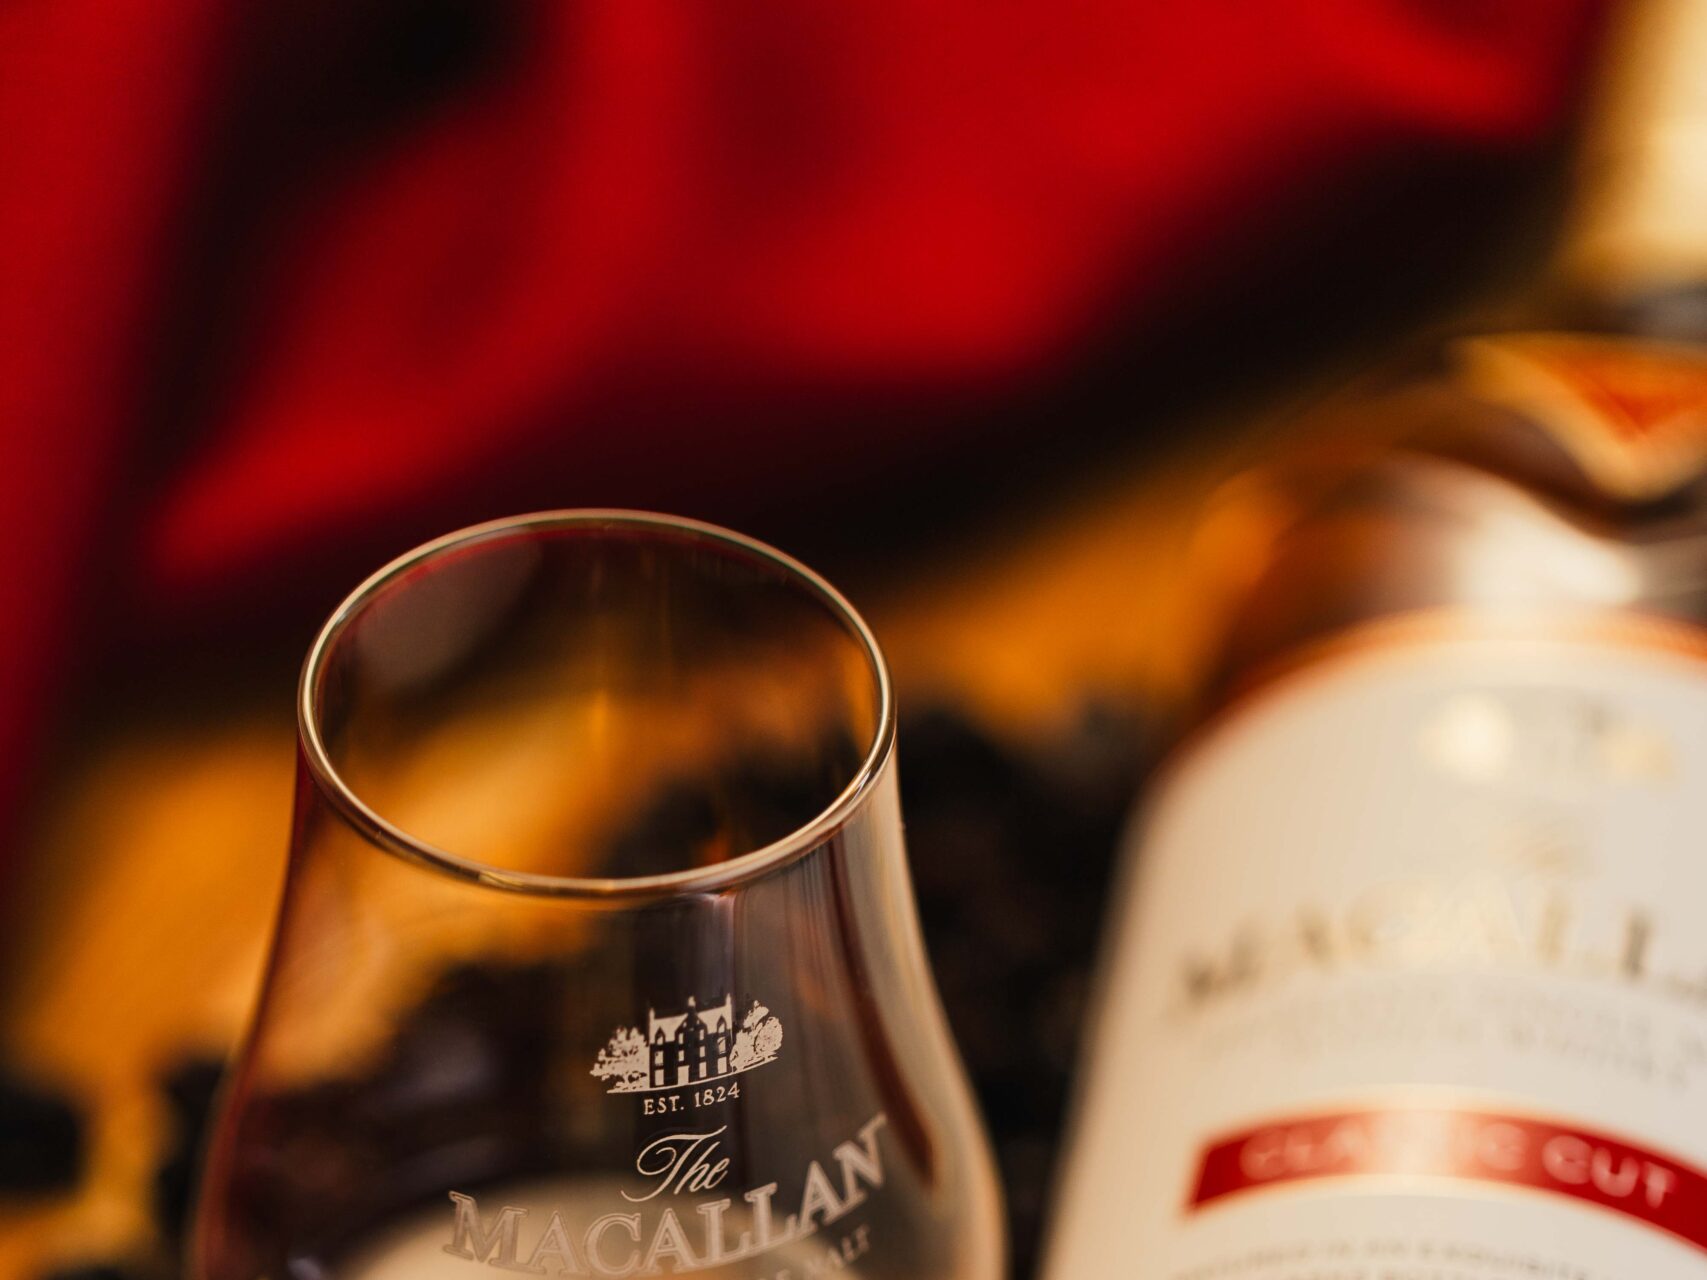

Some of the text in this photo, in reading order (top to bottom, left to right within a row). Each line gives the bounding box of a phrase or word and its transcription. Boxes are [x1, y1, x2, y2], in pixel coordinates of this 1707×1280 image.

[643, 1082, 741, 1115] EST. 1824
[442, 1112, 888, 1279] MACALLAN
[620, 1125, 731, 1202] The
[1541, 1133, 1680, 1210] CUT
